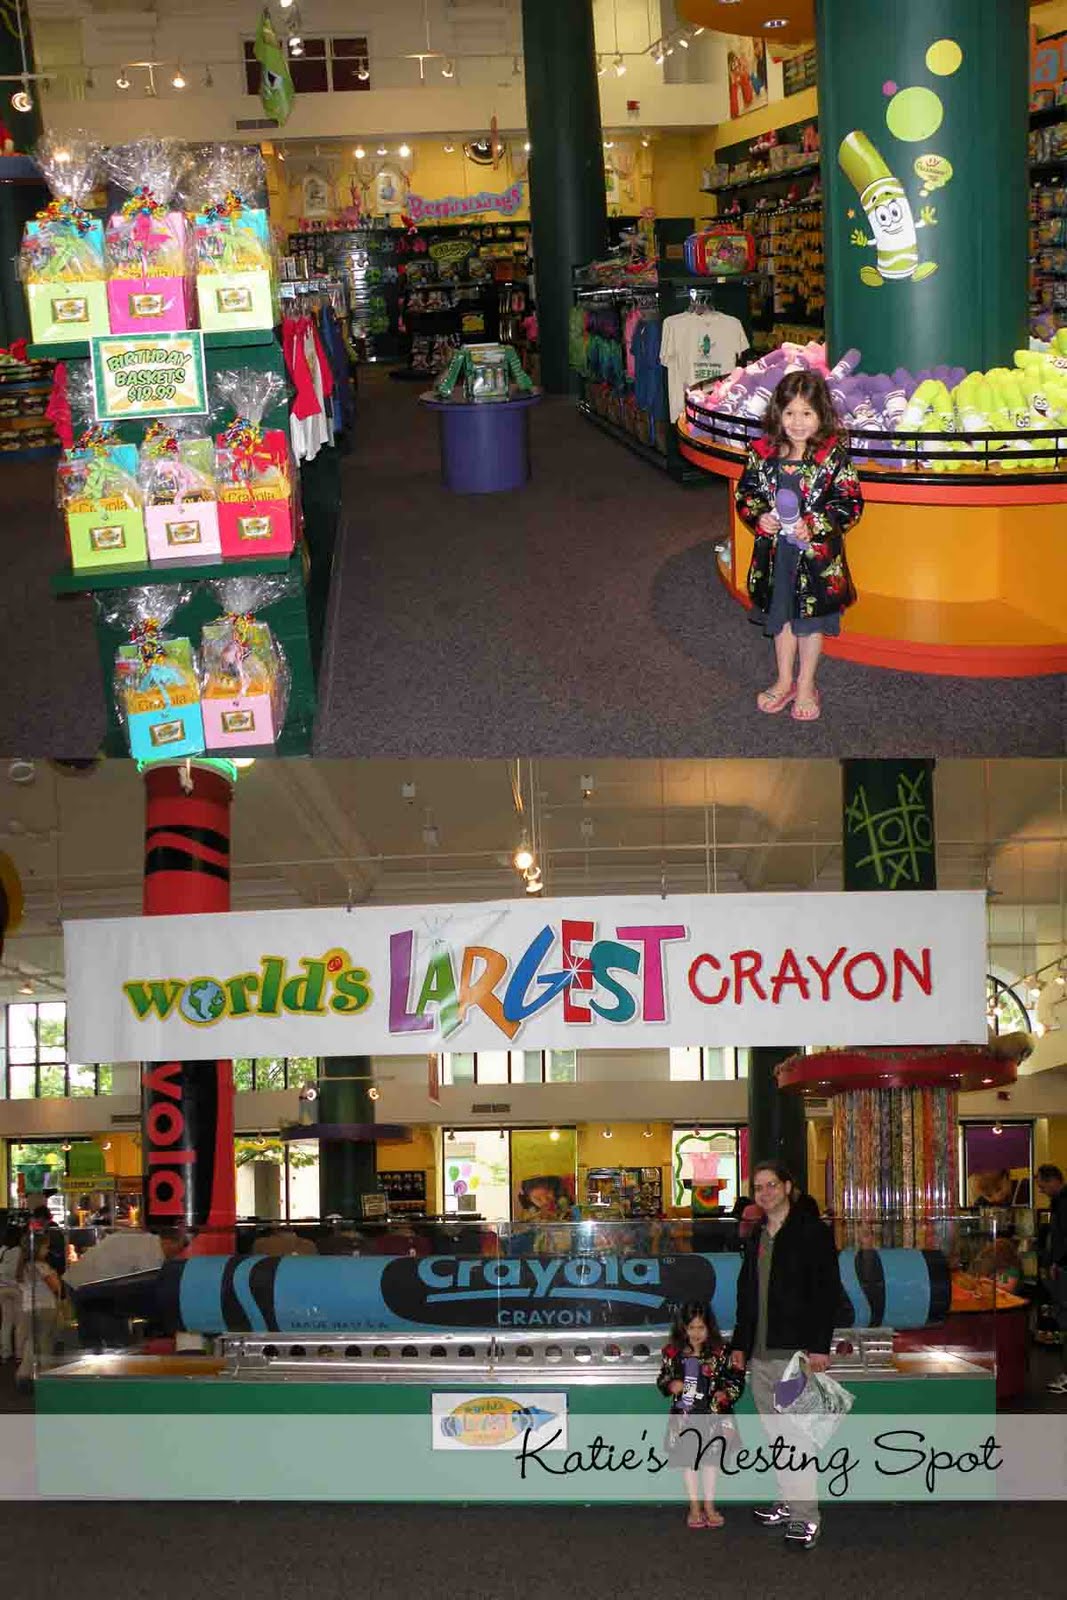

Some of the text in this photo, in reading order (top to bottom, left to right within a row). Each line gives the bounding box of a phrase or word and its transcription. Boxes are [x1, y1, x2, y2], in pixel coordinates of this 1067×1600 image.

[107, 348, 192, 371] BIRTHDAY
[115, 368, 185, 386] BASKETS
[128, 384, 176, 403] $19.99
[227, 491, 275, 503] Craola
[122, 918, 932, 1040] world's LARGEST CRAYON
[417, 1255, 662, 1298] Crayola
[498, 1308, 592, 1326] CRAYON
